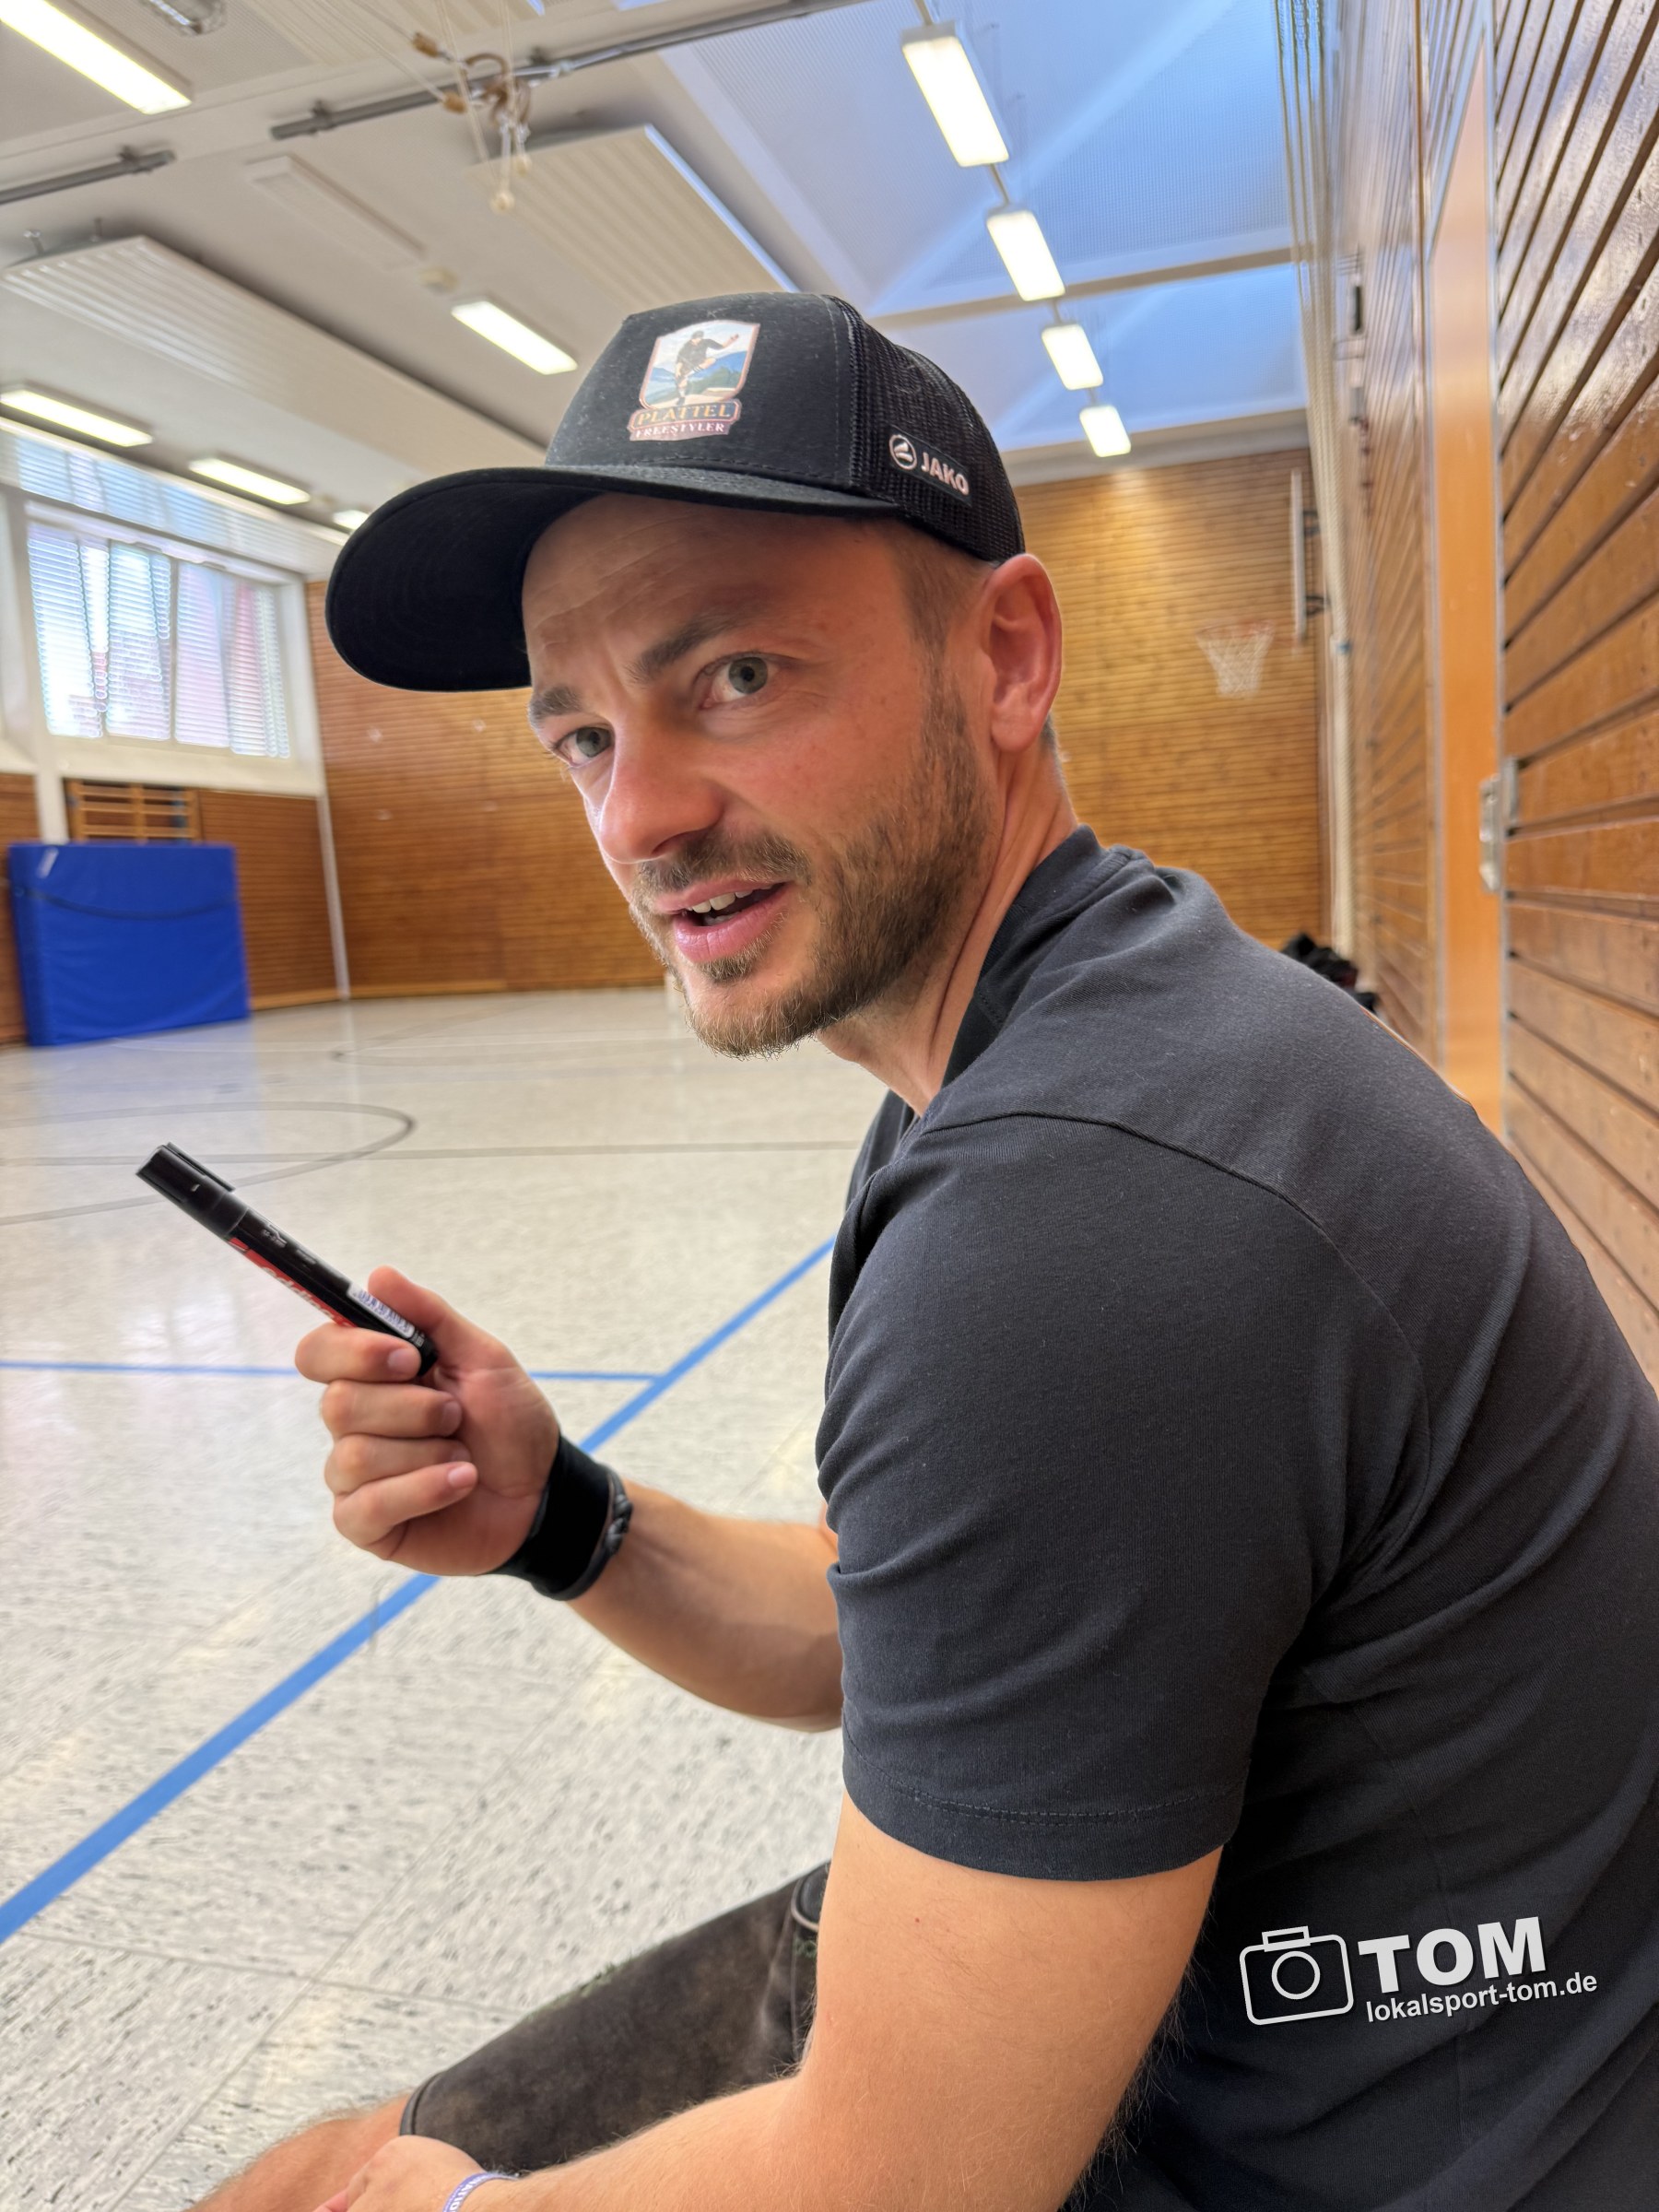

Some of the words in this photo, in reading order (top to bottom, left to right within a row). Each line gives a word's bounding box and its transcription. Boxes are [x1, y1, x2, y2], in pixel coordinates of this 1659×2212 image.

[637, 404, 731, 426] PLATTEL
[635, 421, 725, 438] FREESTYLER
[921, 452, 970, 496] JAKO
